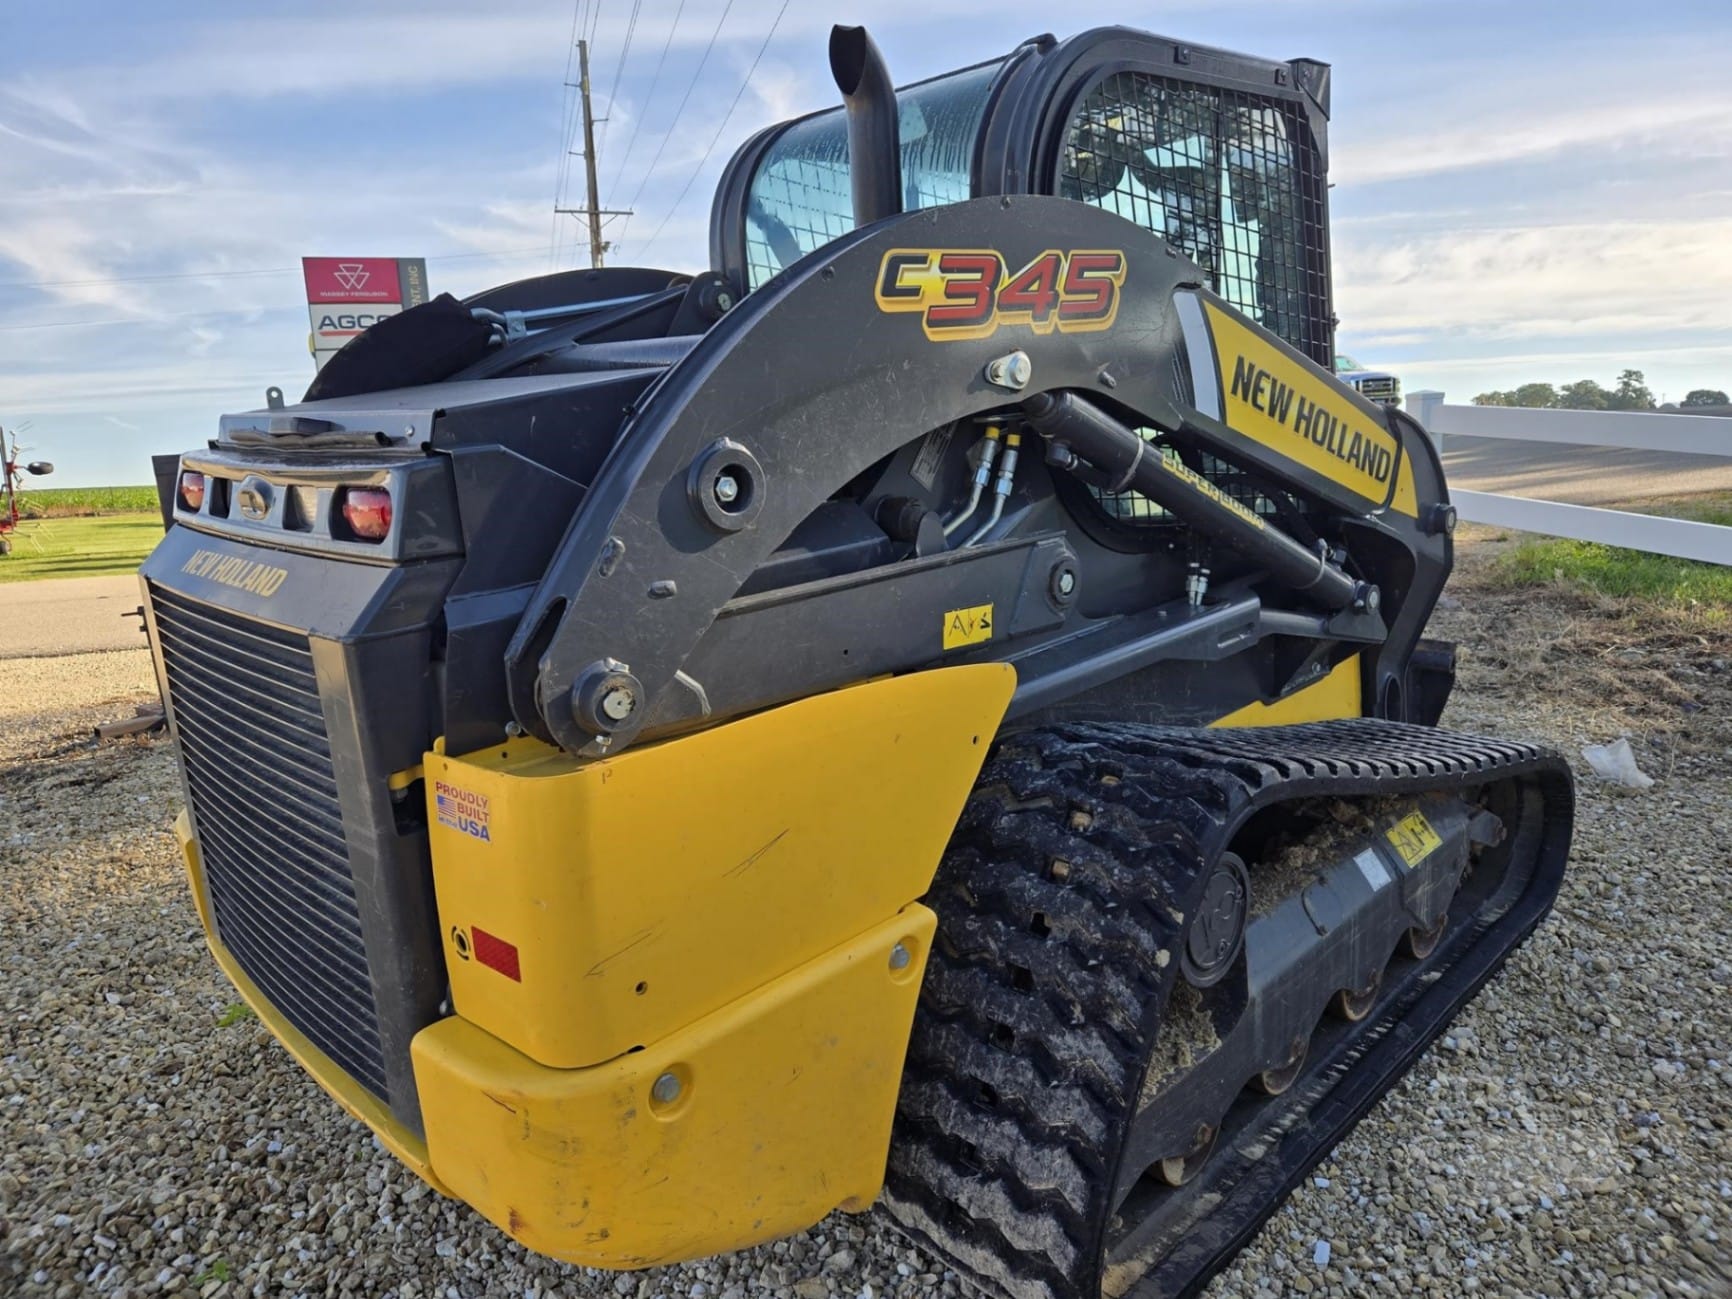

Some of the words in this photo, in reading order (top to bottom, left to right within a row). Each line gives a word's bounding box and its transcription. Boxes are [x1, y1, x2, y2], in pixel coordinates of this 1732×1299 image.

[876, 249, 1127, 341] C345
[1230, 355, 1295, 425] NEW
[1294, 395, 1392, 483] HOLLAND
[181, 549, 223, 577] NEW
[208, 555, 288, 597] HOLLAND
[435, 781, 488, 809] PROUDLY
[457, 802, 489, 823] BUILT
[458, 816, 490, 841] USA
